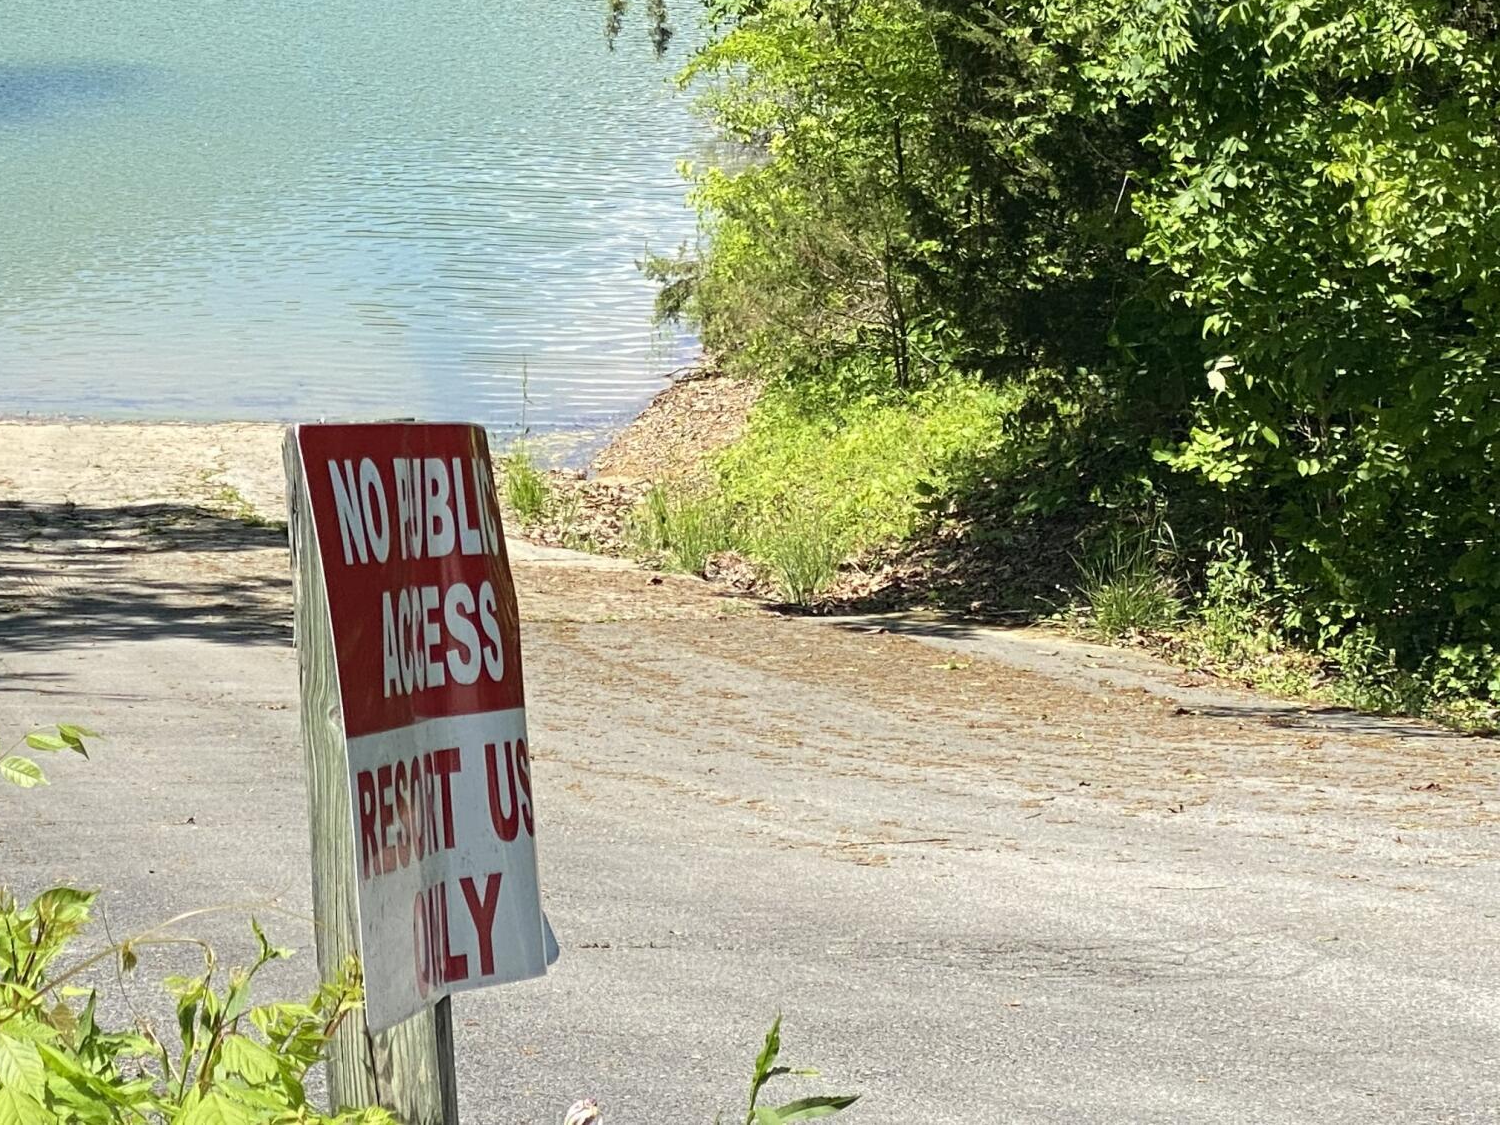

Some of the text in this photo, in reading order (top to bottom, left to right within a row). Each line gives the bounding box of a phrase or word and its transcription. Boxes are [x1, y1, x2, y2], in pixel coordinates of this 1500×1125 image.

[328, 456, 500, 566] NO PUBLIC
[382, 581, 505, 698] ACCESS
[357, 747, 462, 881] RESORT
[413, 872, 503, 999] ONLY
